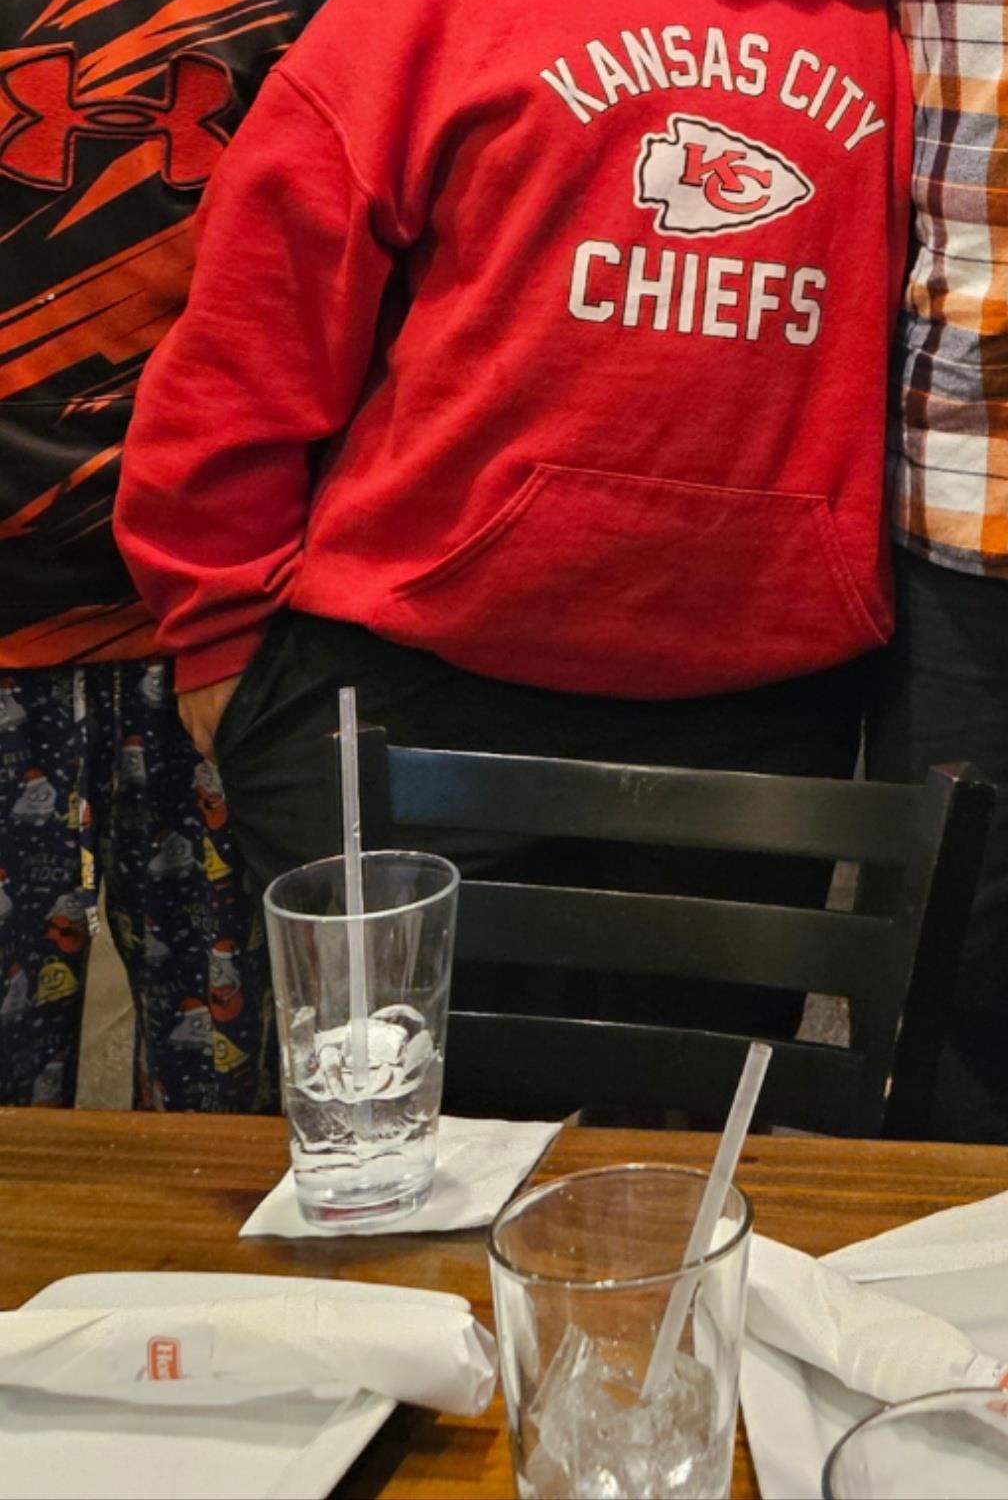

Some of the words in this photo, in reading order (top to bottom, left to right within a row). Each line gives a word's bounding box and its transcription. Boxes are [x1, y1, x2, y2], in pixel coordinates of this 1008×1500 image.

[539, 24, 770, 125] KANSAS
[778, 49, 886, 153] CITY
[679, 142, 773, 215] KC
[567, 239, 828, 347] CHIEFS
